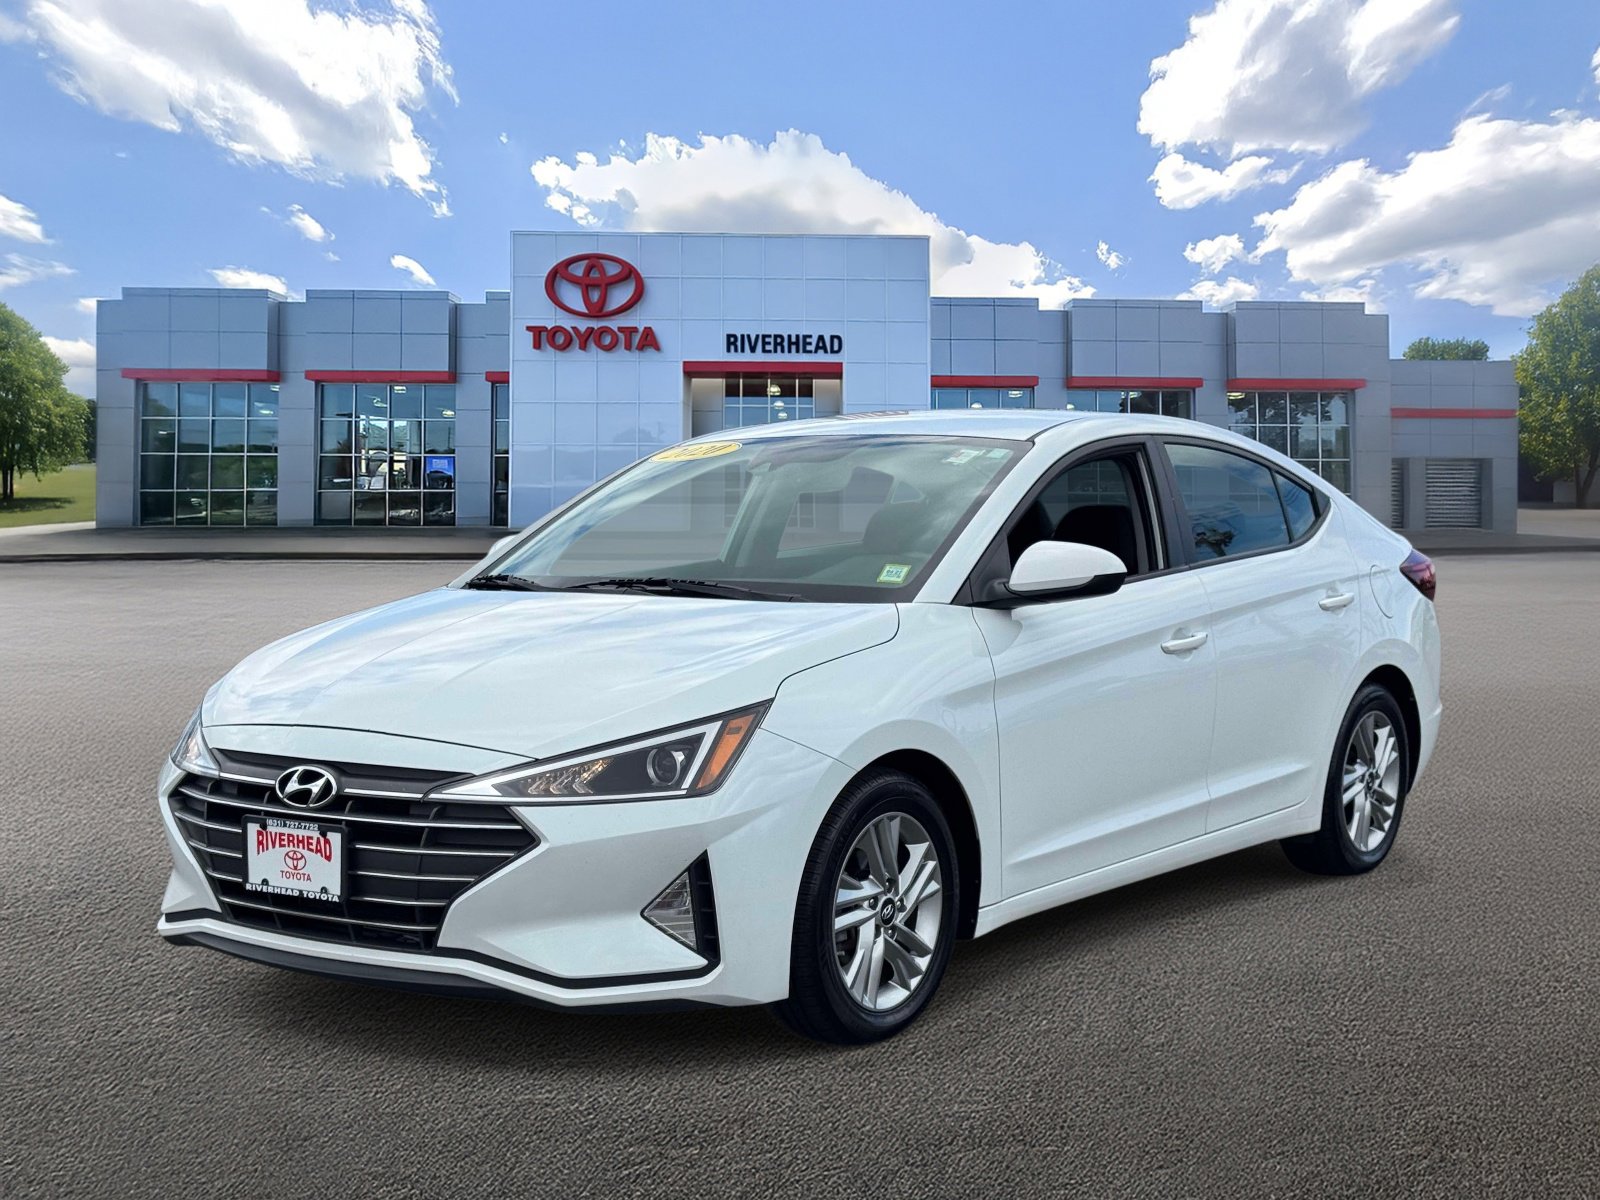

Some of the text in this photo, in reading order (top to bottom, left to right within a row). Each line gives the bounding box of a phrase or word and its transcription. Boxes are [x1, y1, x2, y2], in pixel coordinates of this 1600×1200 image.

[526, 325, 660, 352] TOYOTA
[726, 333, 843, 354] RIVERHEAD
[256, 829, 333, 862] RIVERHEAD
[280, 870, 312, 882] TOYOTA
[245, 883, 340, 902] RIVERHEAD TOYOTA
